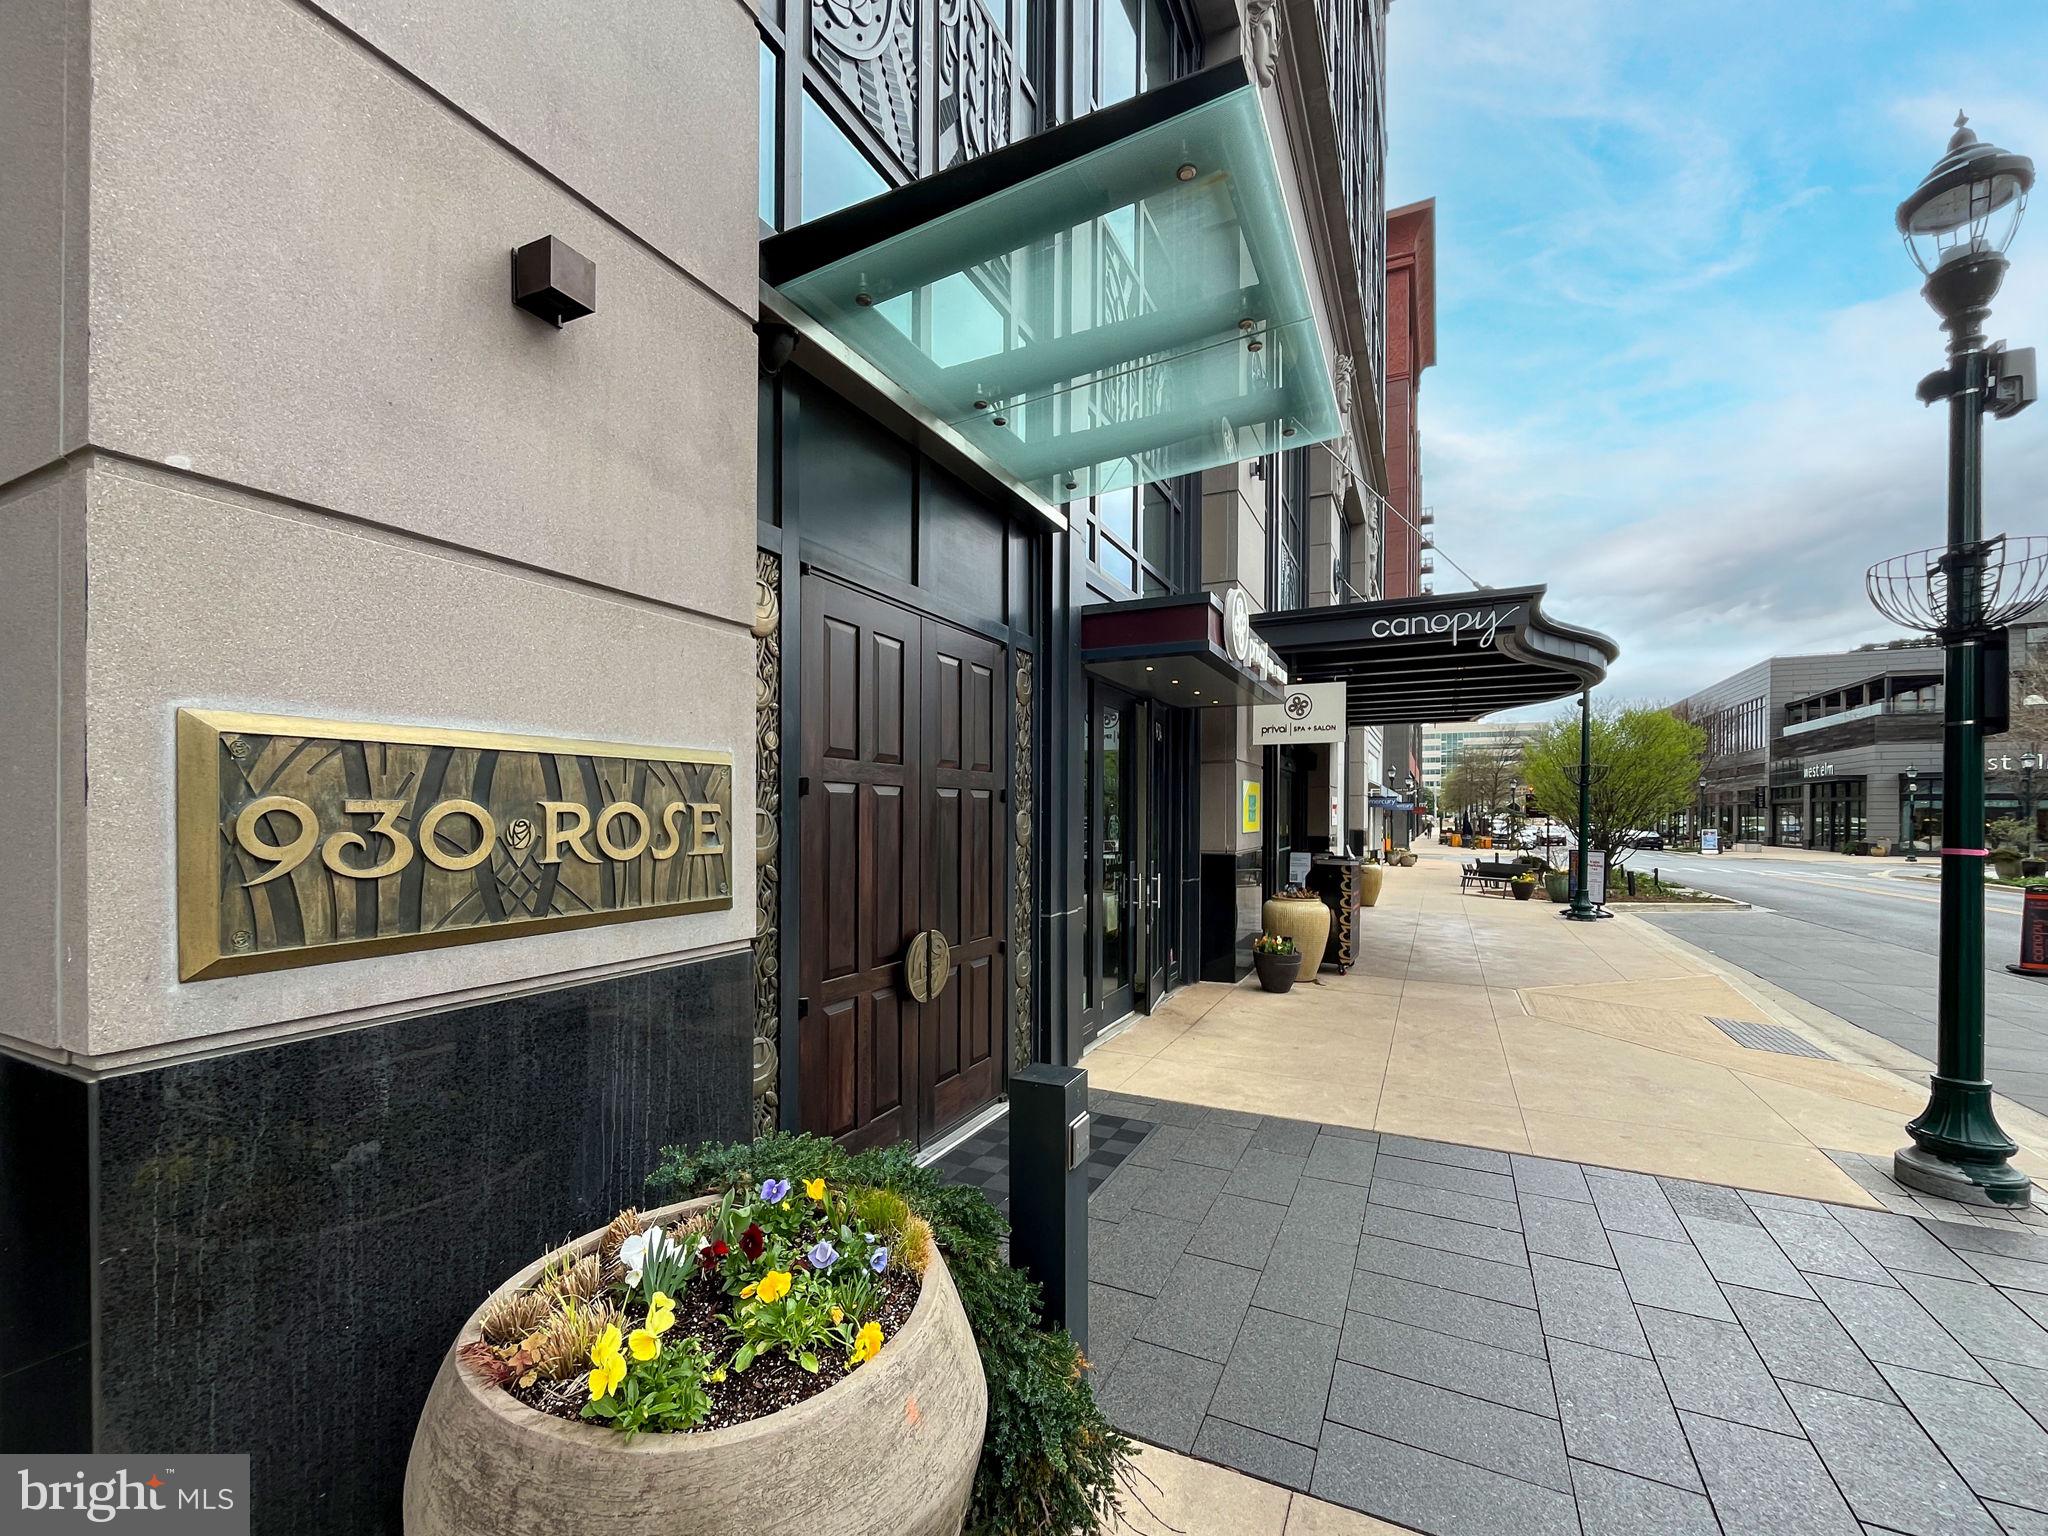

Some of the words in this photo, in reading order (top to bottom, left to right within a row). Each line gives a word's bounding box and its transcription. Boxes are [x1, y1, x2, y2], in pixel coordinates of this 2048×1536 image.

[1371, 605, 1521, 648] canopy
[1313, 724, 1337, 732] SALON
[1803, 763, 1819, 779] west
[1820, 761, 1834, 777] elm
[235, 795, 497, 888] 930
[536, 801, 725, 865] ROSE
